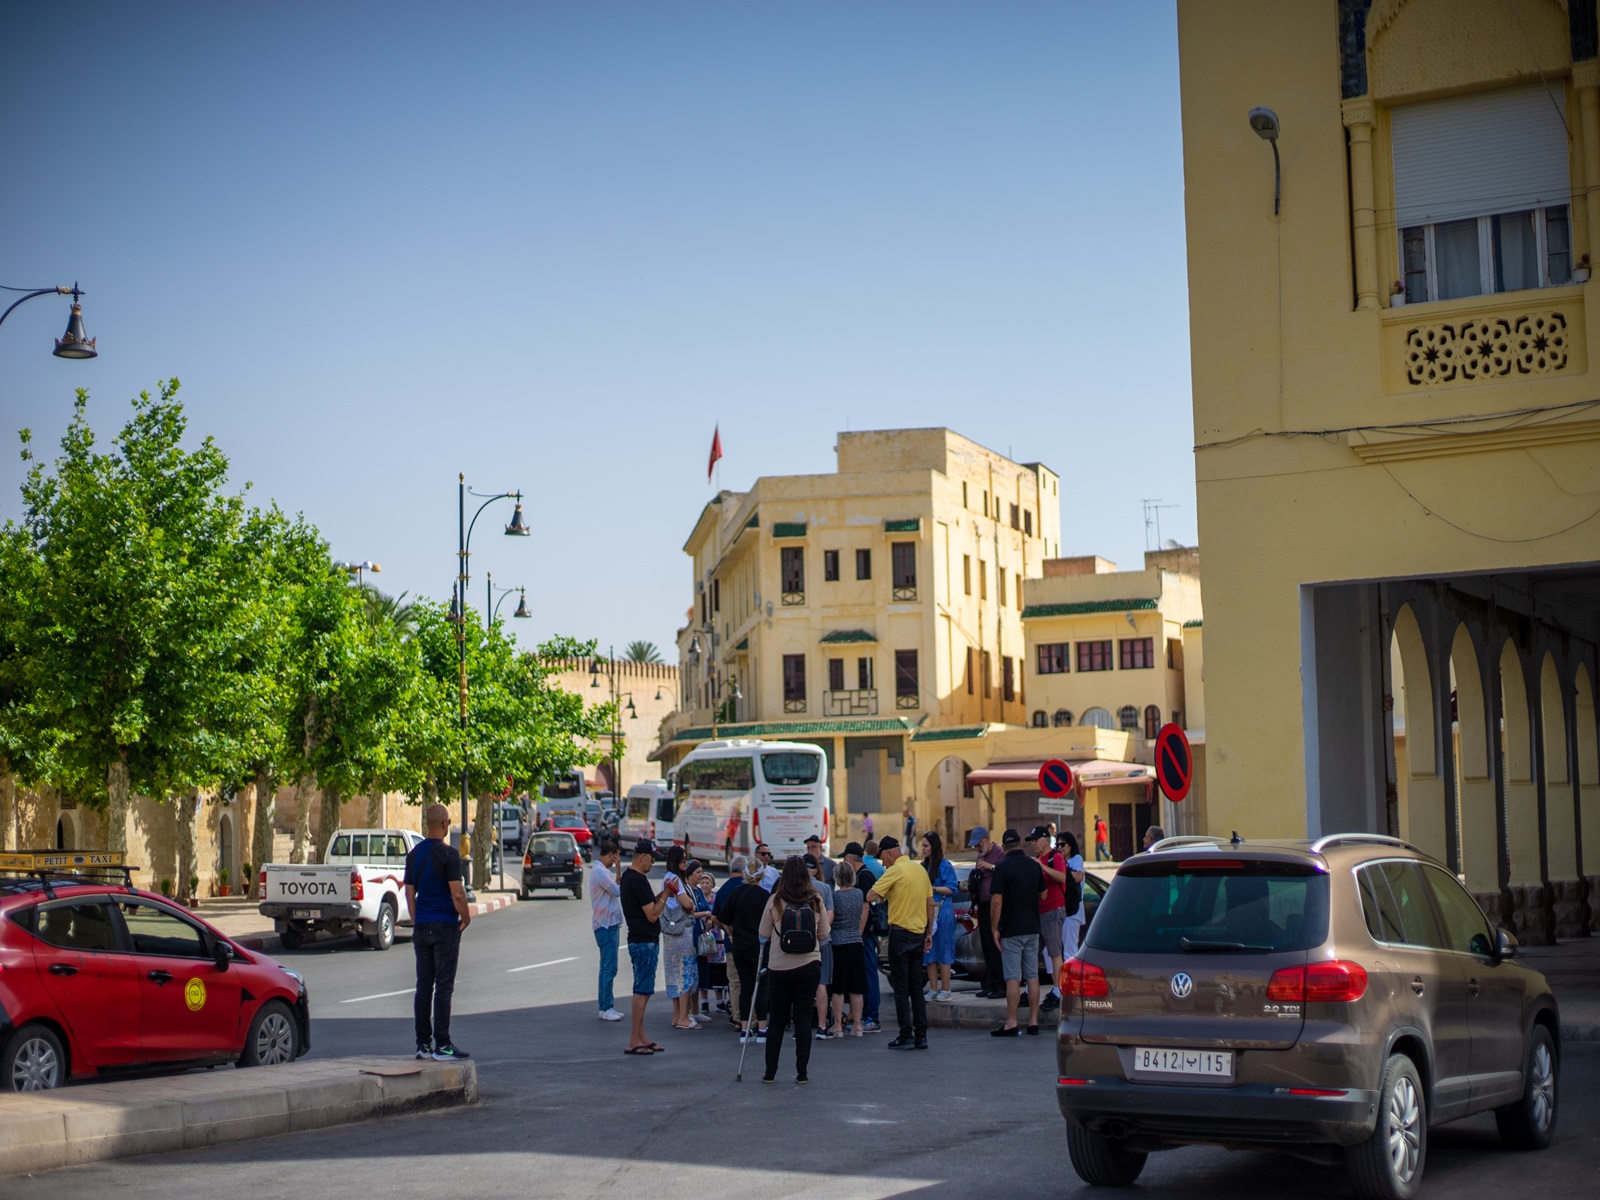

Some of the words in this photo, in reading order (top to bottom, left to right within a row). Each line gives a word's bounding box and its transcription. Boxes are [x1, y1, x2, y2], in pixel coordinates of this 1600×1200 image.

[44, 857, 68, 865] PETIT
[89, 855, 112, 863] TAXI
[279, 882, 337, 895] TOYOTA
[1085, 1000, 1112, 1009] TIGUAN
[1143, 1050, 1178, 1070] 8412
[1207, 1054, 1223, 1072] 15
